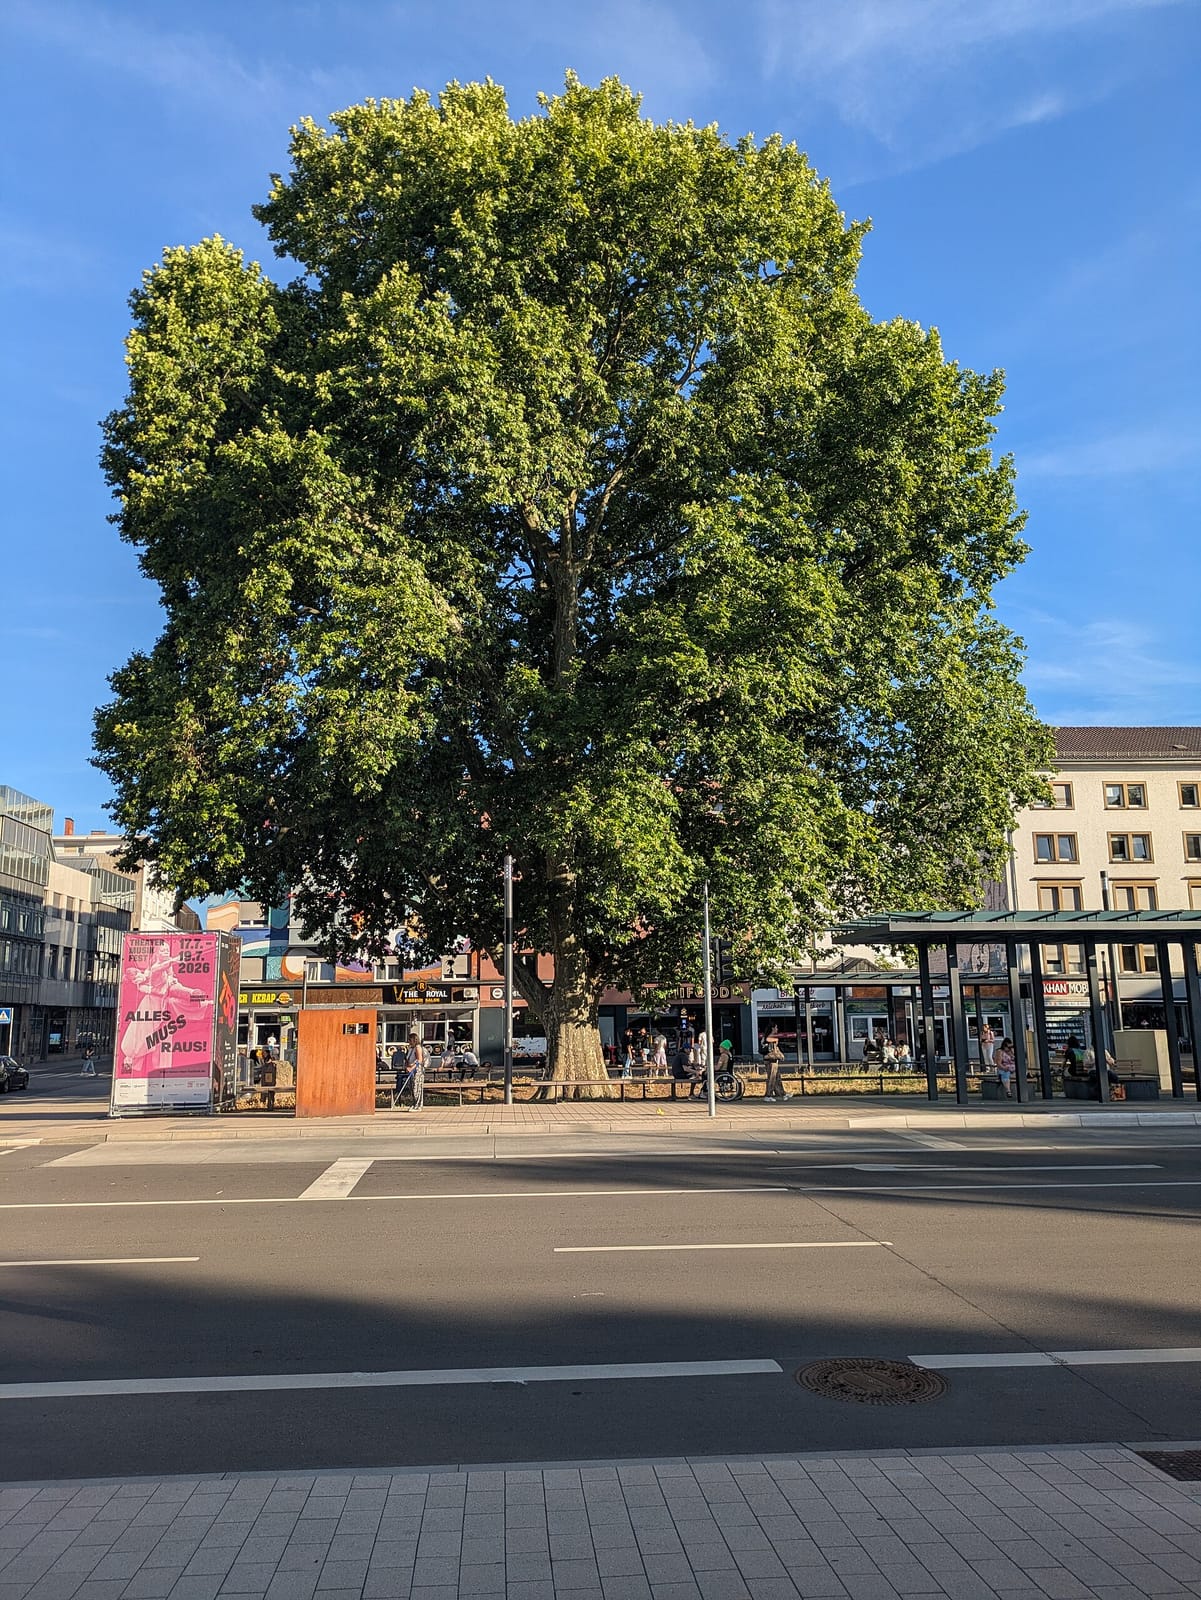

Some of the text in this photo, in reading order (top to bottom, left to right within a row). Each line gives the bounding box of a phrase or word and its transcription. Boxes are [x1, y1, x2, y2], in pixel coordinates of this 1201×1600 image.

[130, 939, 165, 947] THEATER
[180, 938, 204, 949] 17.7.
[129, 946, 154, 954] MUSIK
[128, 954, 149, 962] FEST
[179, 951, 205, 961] 19.7.
[178, 962, 210, 973] 2026
[1043, 983, 1066, 993] KHAN
[252, 993, 276, 1004] KEBAP
[403, 990, 448, 998] THE ROYAL
[125, 1011, 172, 1022] ALLES
[145, 1015, 187, 1050] MUSS
[160, 1041, 207, 1052] RAUS!
